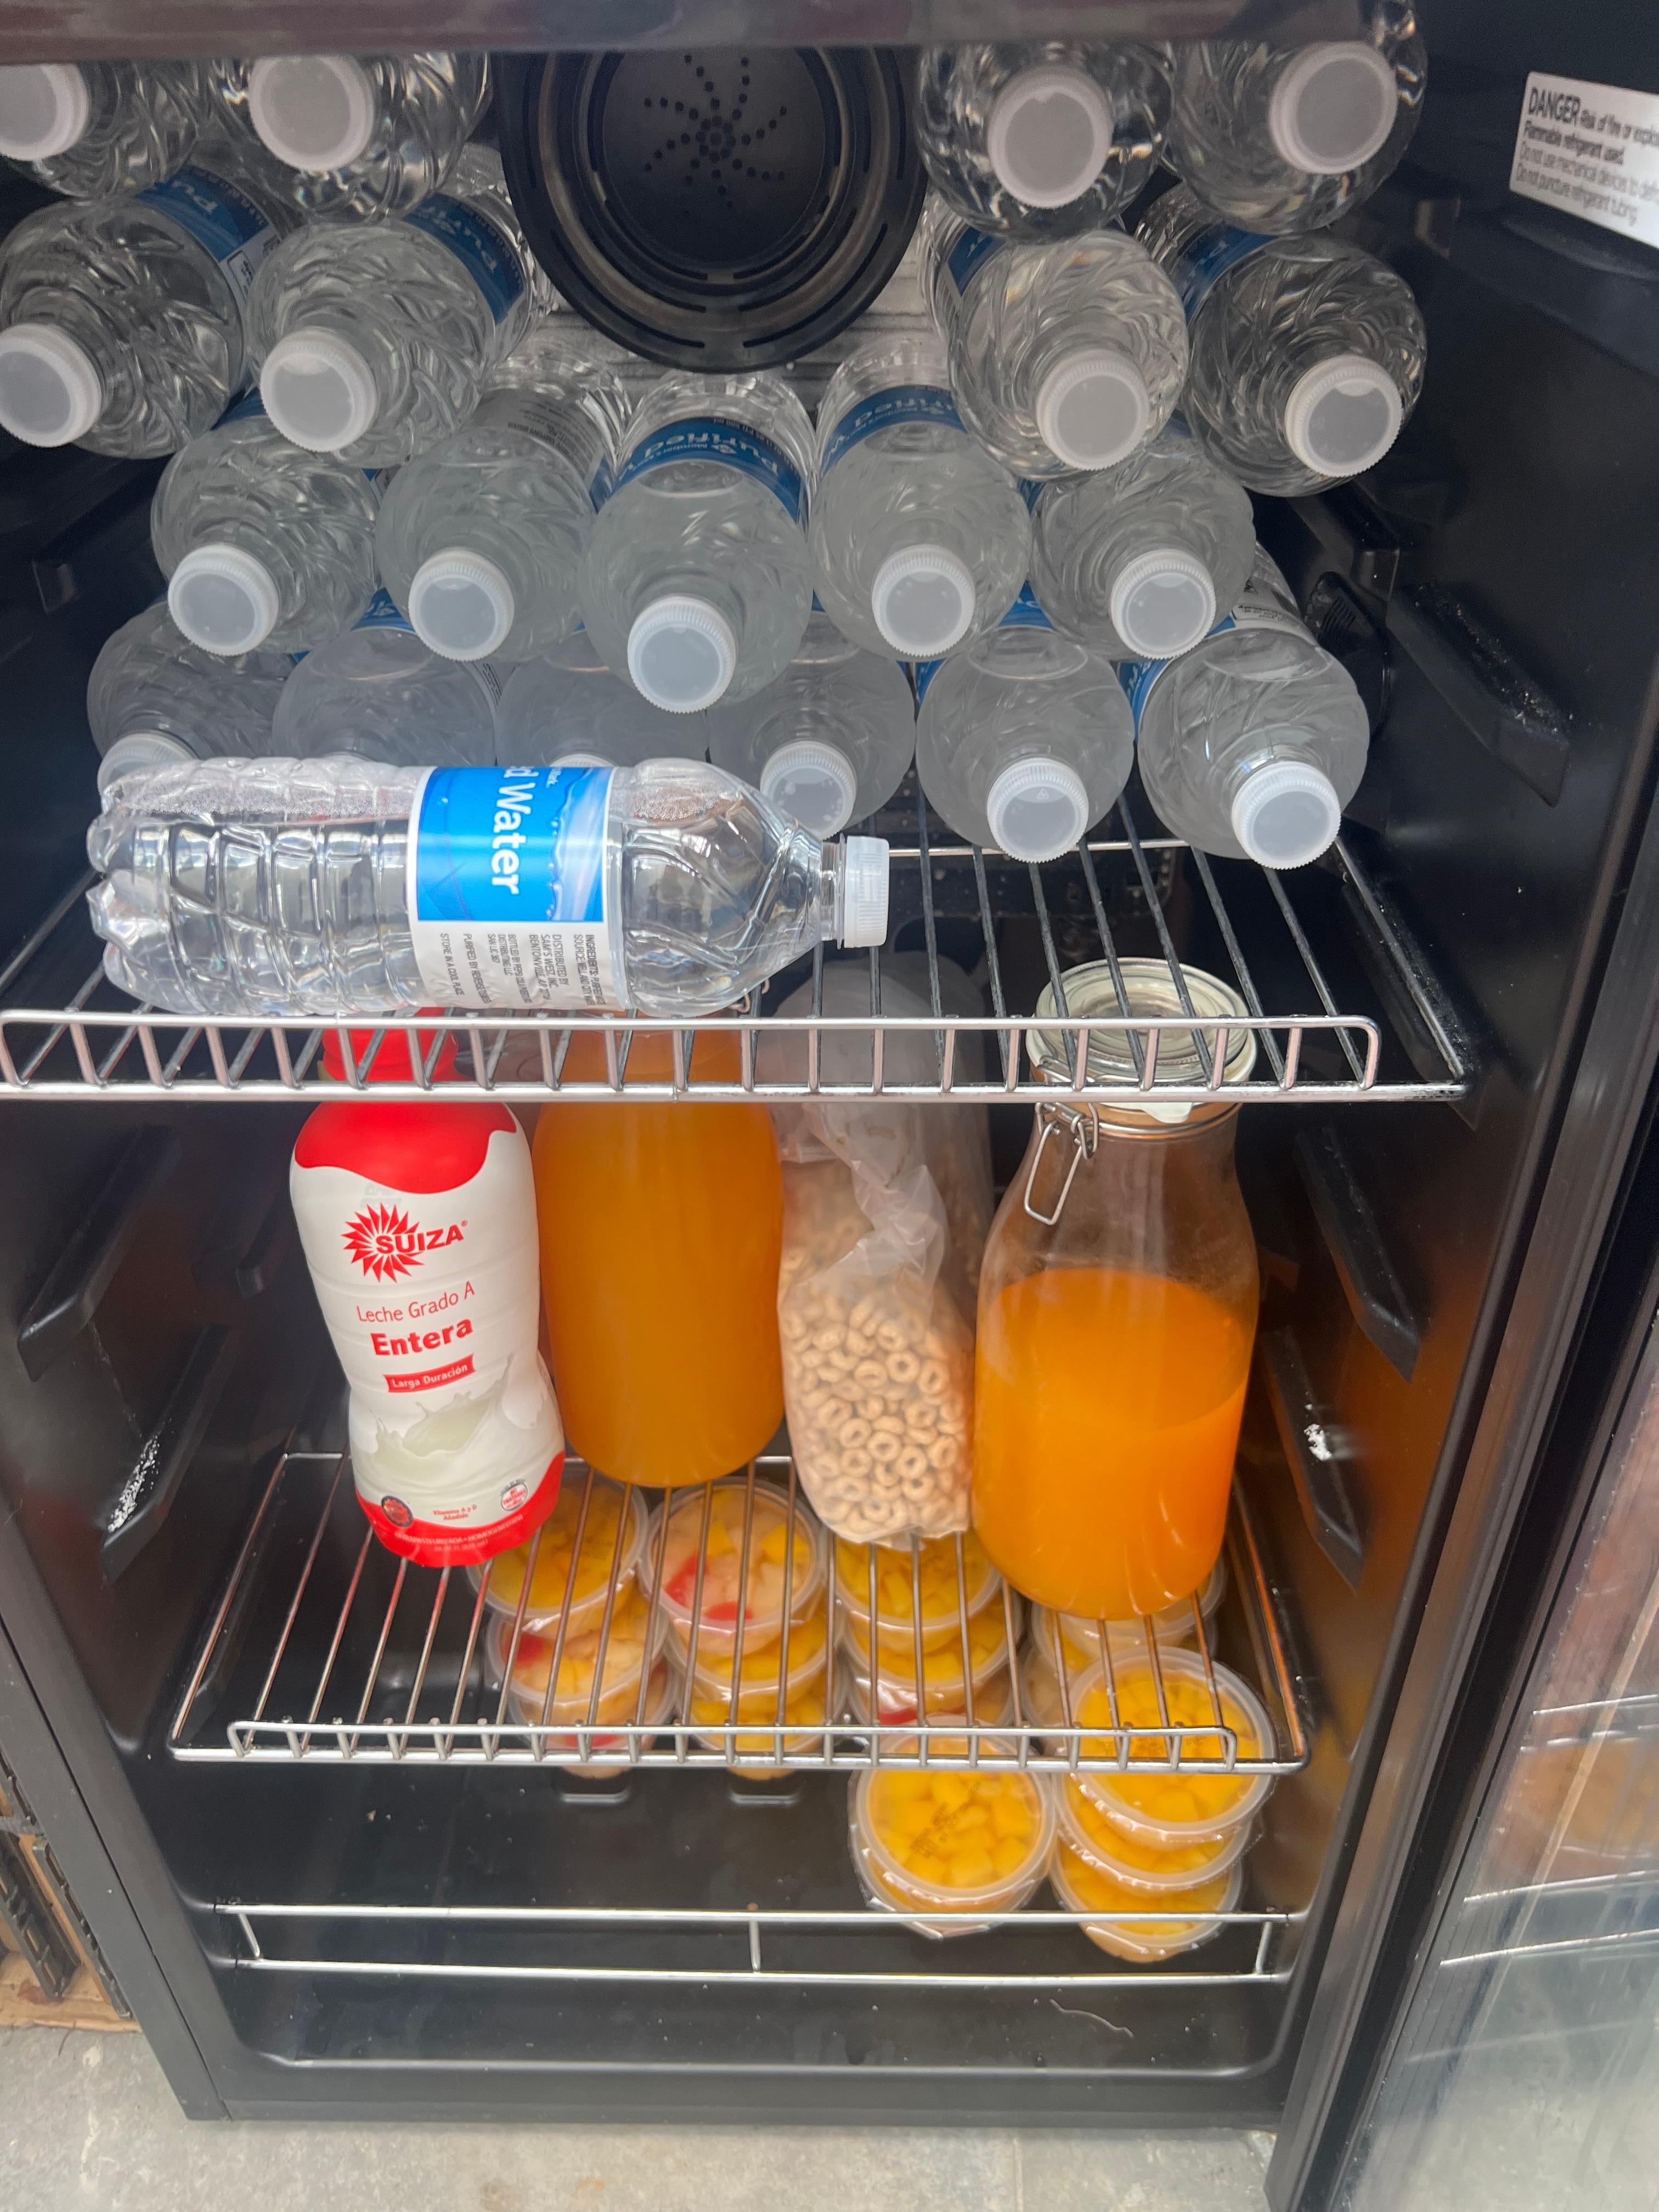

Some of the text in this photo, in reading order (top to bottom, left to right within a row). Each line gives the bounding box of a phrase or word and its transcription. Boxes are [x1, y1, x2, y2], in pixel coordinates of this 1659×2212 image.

[492, 782, 537, 895] Water
[441, 933, 453, 955] STORE
[508, 934, 520, 956] BOTTLED
[540, 934, 553, 958] SAM'S
[469, 961, 479, 970] BY
[552, 934, 570, 986] DISTRIBUTED BY
[376, 1224, 465, 1254] SUIZA
[356, 1280, 476, 1322] Leche Grado A
[370, 1318, 474, 1356] Entera
[391, 1363, 469, 1389] Larga Duración
